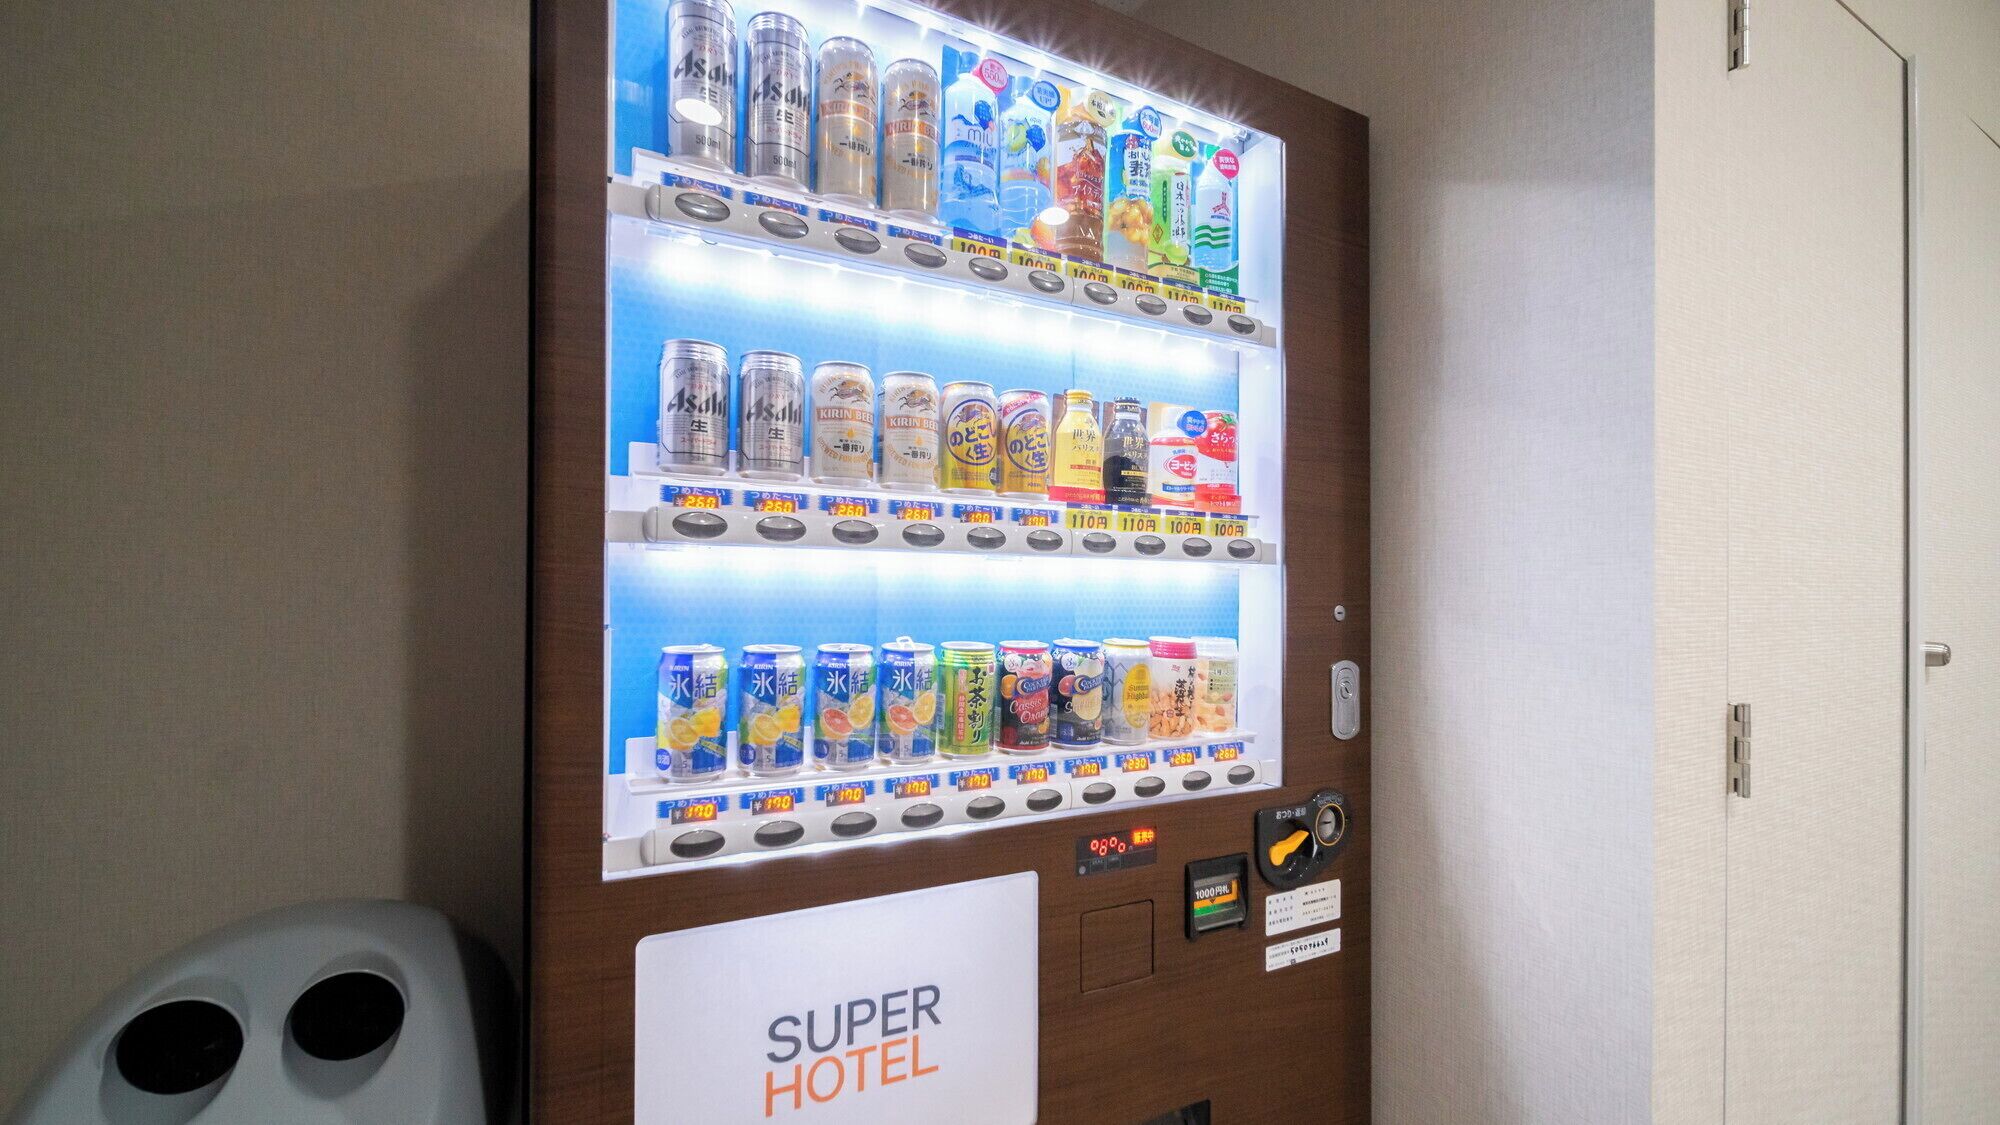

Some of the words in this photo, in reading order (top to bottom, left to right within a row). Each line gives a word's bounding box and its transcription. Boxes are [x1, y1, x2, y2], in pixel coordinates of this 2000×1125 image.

[695, 134, 721, 150] 500ml
[667, 387, 727, 418] Asahi
[746, 396, 802, 426] Asahi
[820, 408, 852, 420] KIRIN
[690, 419, 709, 434] 生
[890, 417, 921, 428] KIRIN
[767, 427, 785, 441] 生
[1211, 431, 1238, 444] さらっ
[833, 443, 865, 454] 一番搾り
[903, 450, 932, 460] 一番搾り
[1072, 513, 1108, 529] 110円
[1122, 517, 1156, 532] 110円
[1170, 520, 1202, 534] 100円
[1215, 523, 1244, 537] 100円
[669, 673, 718, 700] 氷結
[752, 672, 799, 698] 氷結
[826, 670, 870, 695] 氷結
[892, 668, 934, 692] 氷結
[1195, 883, 1230, 900] 1000円札
[767, 985, 941, 1063] SUPER
[765, 1034, 939, 1118] HOTEL
